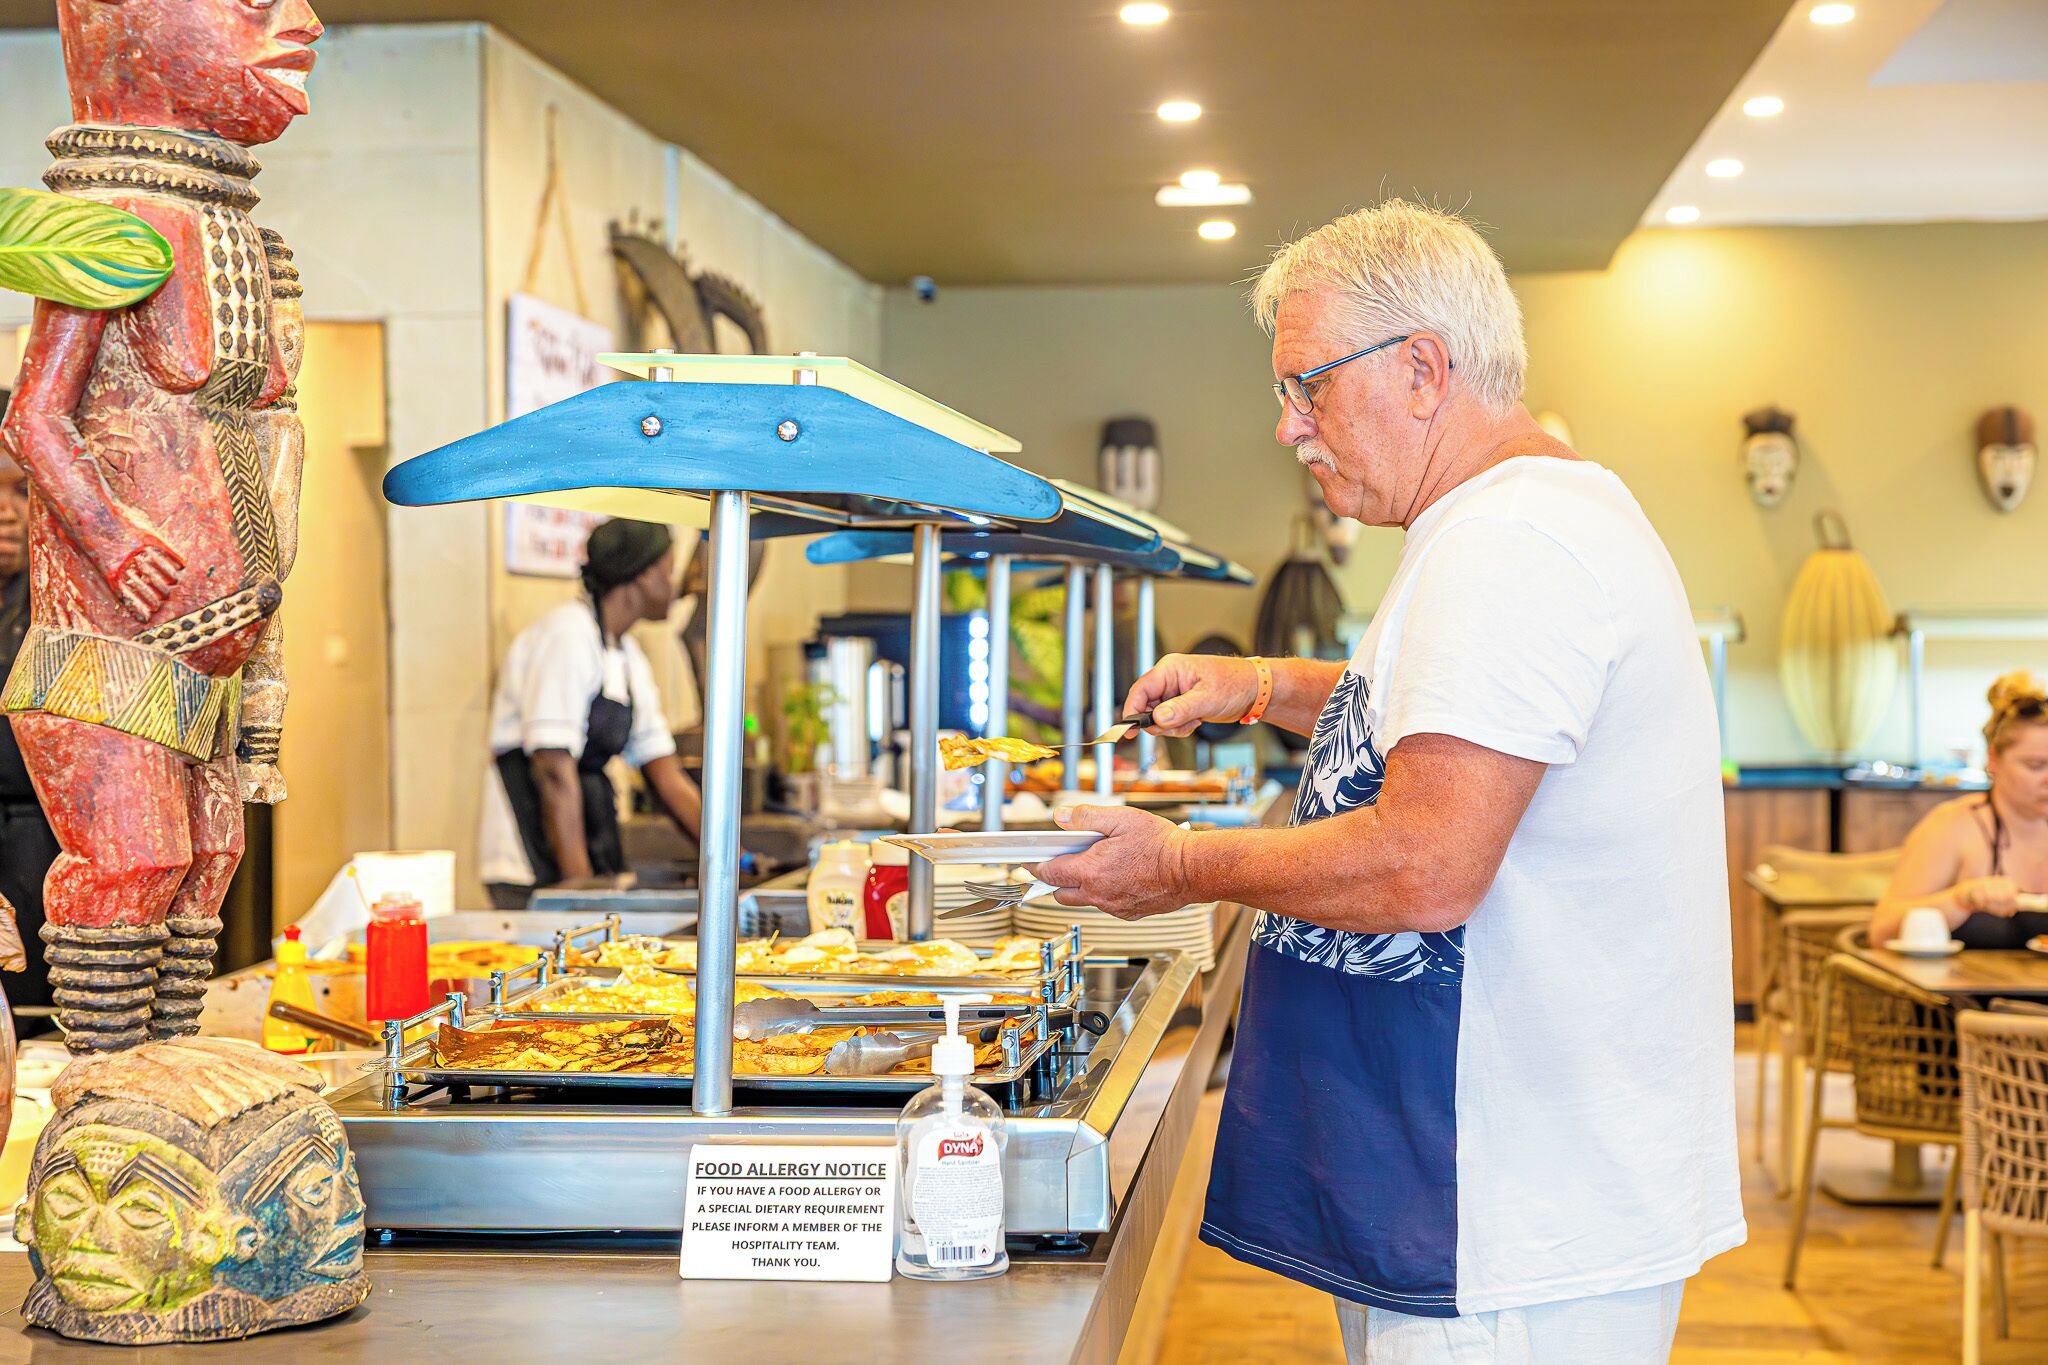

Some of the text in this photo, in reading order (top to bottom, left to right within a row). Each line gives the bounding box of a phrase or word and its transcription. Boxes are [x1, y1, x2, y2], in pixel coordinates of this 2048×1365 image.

[943, 1141, 979, 1154] DYNA
[695, 1162, 887, 1177] FOOD ALLERGY NOTICE
[697, 1186, 881, 1196] IF YOU HAVE A FOOD ALLERGY OR
[698, 1204, 885, 1216] A SPECIAL DIETARY REQUIREMENT
[691, 1222, 882, 1232] PLEASE INFORM A MEMBER OF THE
[731, 1240, 840, 1251] HOSPITALITY TEAM.
[751, 1257, 821, 1267] THANK YOU.
